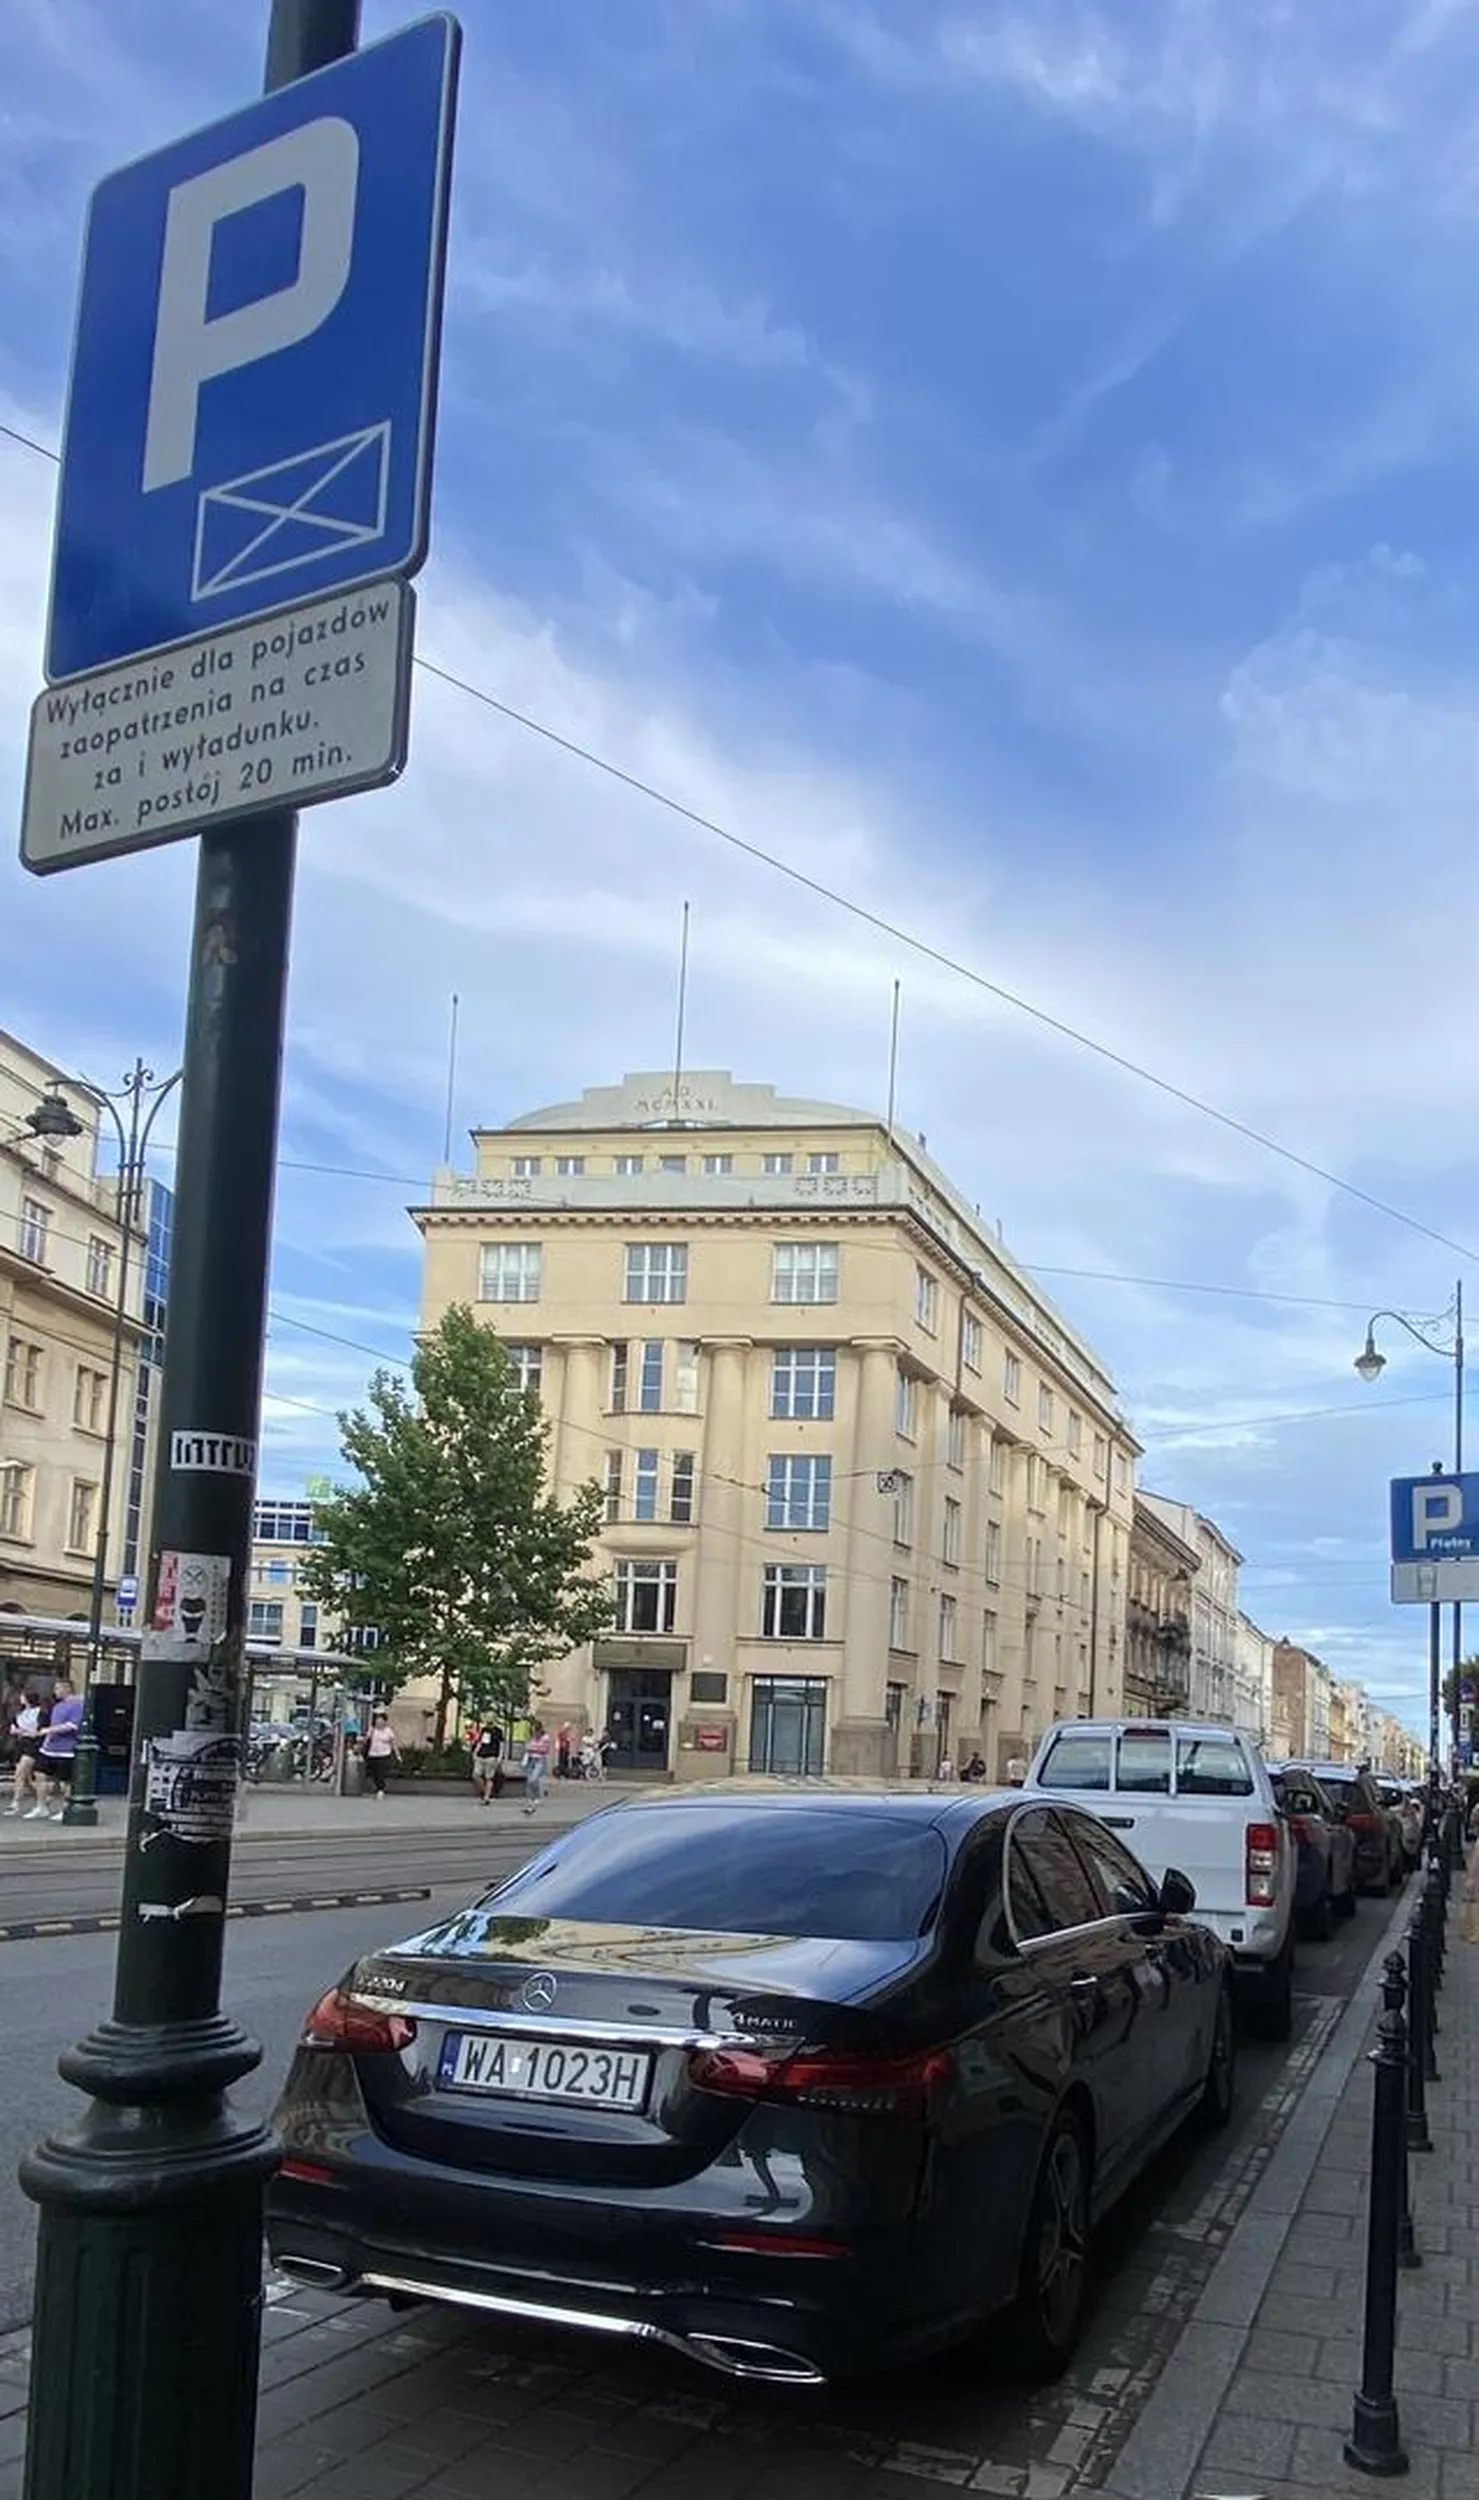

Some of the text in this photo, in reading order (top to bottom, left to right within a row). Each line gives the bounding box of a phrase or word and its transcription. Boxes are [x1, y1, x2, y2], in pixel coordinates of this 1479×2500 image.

[142, 116, 359, 492] P
[46, 599, 391, 727] Wyłącznie dla pojazdów
[60, 652, 366, 759] zaopatrzenia na czas
[59, 738, 352, 840] Max. postój 20 min.
[94, 709, 319, 791] za i wyładunku.
[1413, 1484, 1462, 1549] P
[461, 2039, 640, 2100] WA 1023H
